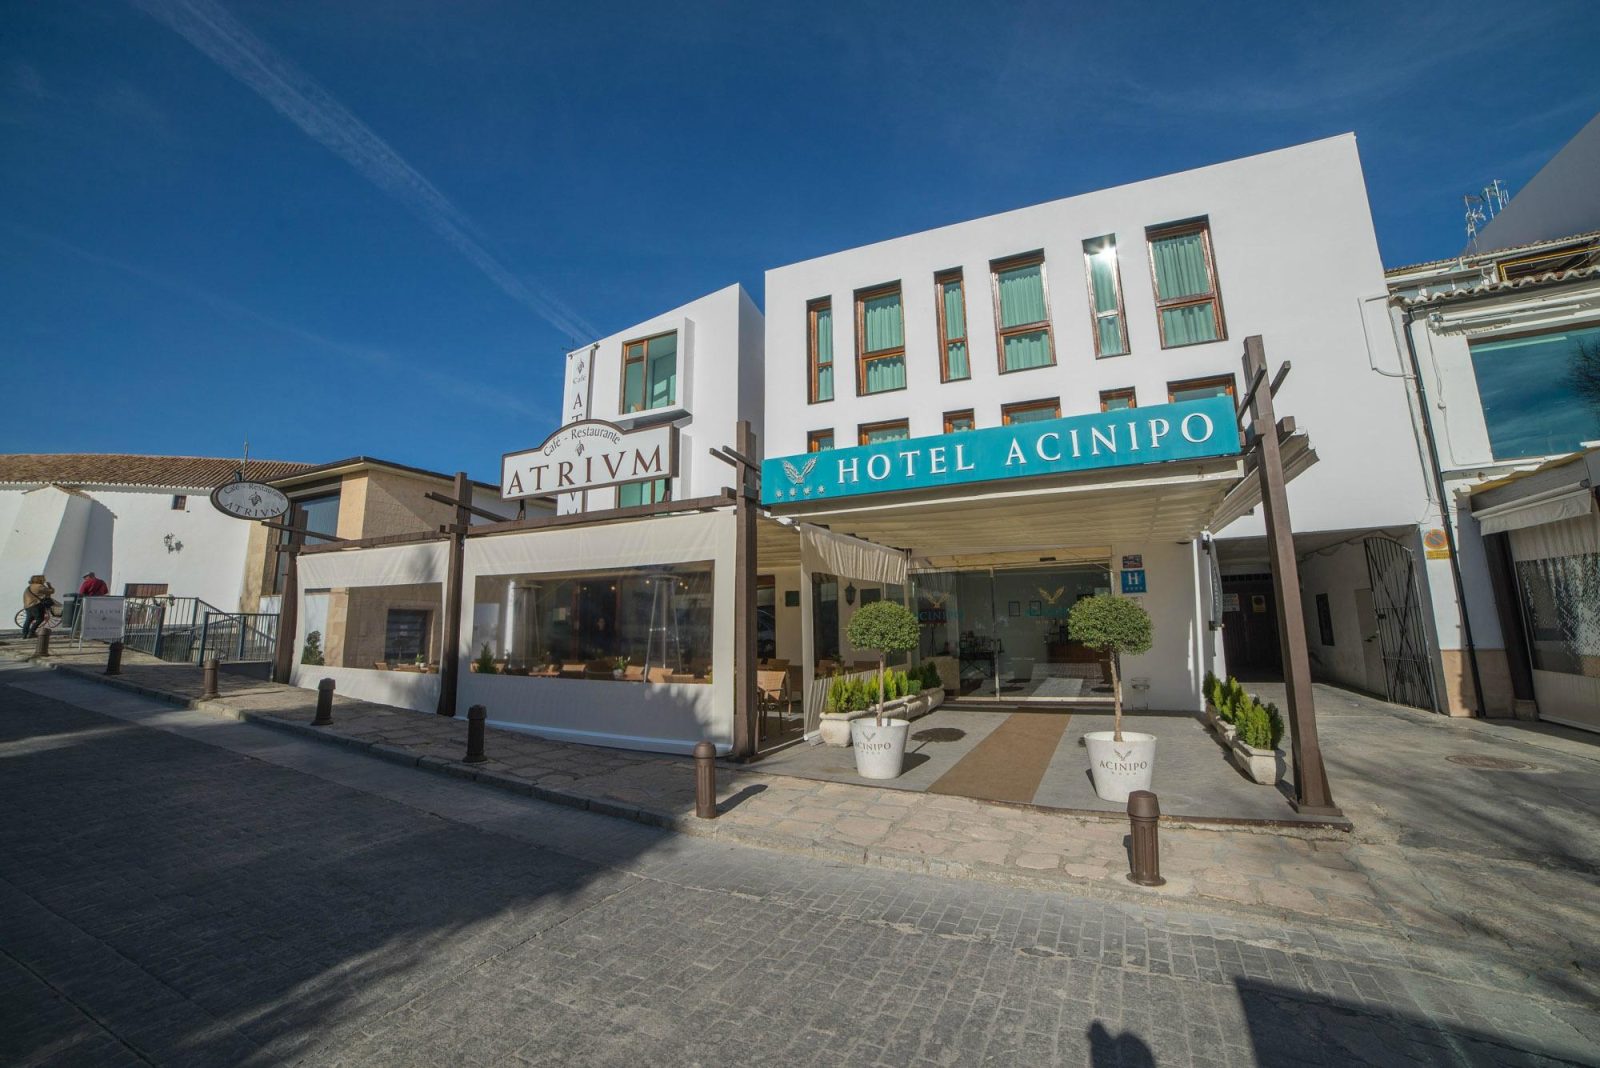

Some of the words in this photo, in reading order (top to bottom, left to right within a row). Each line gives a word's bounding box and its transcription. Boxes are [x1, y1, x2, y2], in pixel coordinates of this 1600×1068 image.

[543, 436, 562, 457] Café
[571, 426, 621, 445] Restaurante
[837, 444, 975, 484] HOTEL
[1005, 413, 1214, 466] ACINIPO
[507, 444, 663, 495] ATRIVM
[224, 502, 281, 517] ATRIVM
[1128, 572, 1139, 585] H
[1099, 760, 1148, 772] ACINIPO
